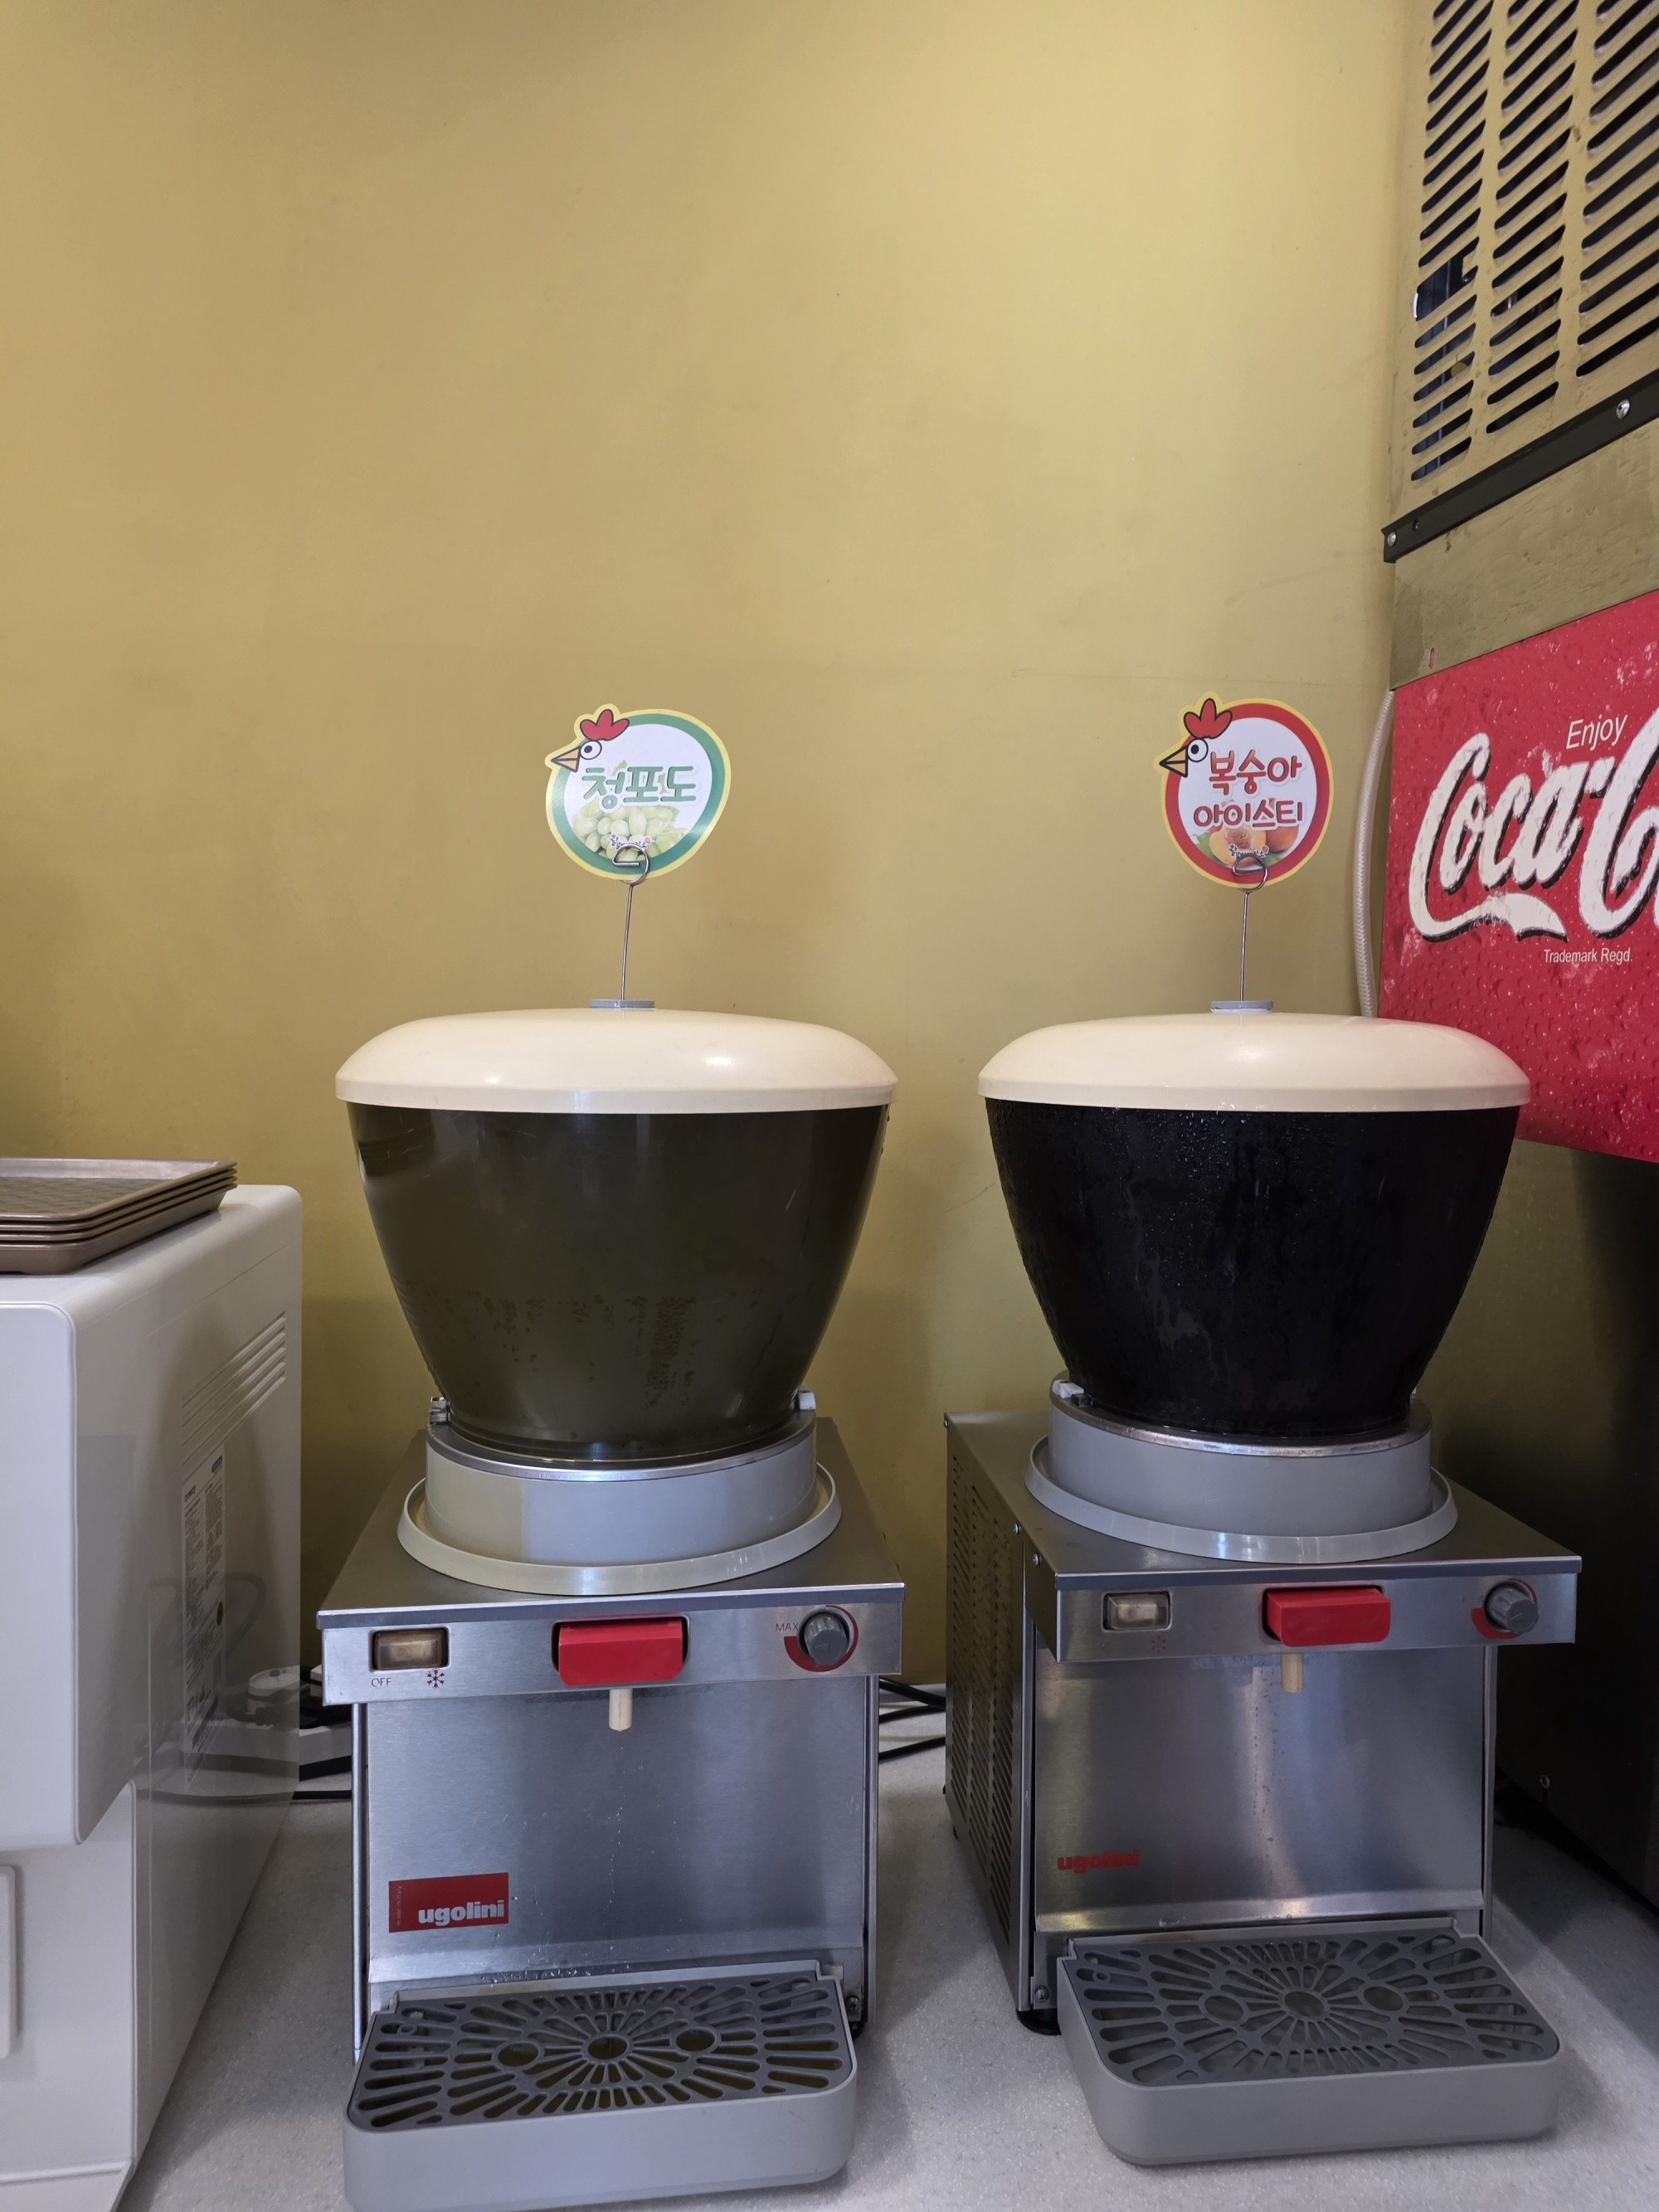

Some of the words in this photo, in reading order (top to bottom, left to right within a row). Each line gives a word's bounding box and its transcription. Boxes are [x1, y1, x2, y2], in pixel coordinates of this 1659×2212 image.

[1566, 713, 1627, 751] Enjoy
[1209, 748, 1303, 796] 복숭아
[581, 765, 698, 810] 청포도
[1193, 798, 1303, 829] 아이스티
[1408, 705, 1659, 943] Coca-C
[1544, 948, 1598, 964] Trademark
[1600, 947, 1633, 965] Regd.
[775, 1621, 799, 1632] MAX
[371, 1676, 392, 1688] OFF
[1057, 1848, 1141, 1874] ugolini
[418, 1899, 505, 1927] ugolini
